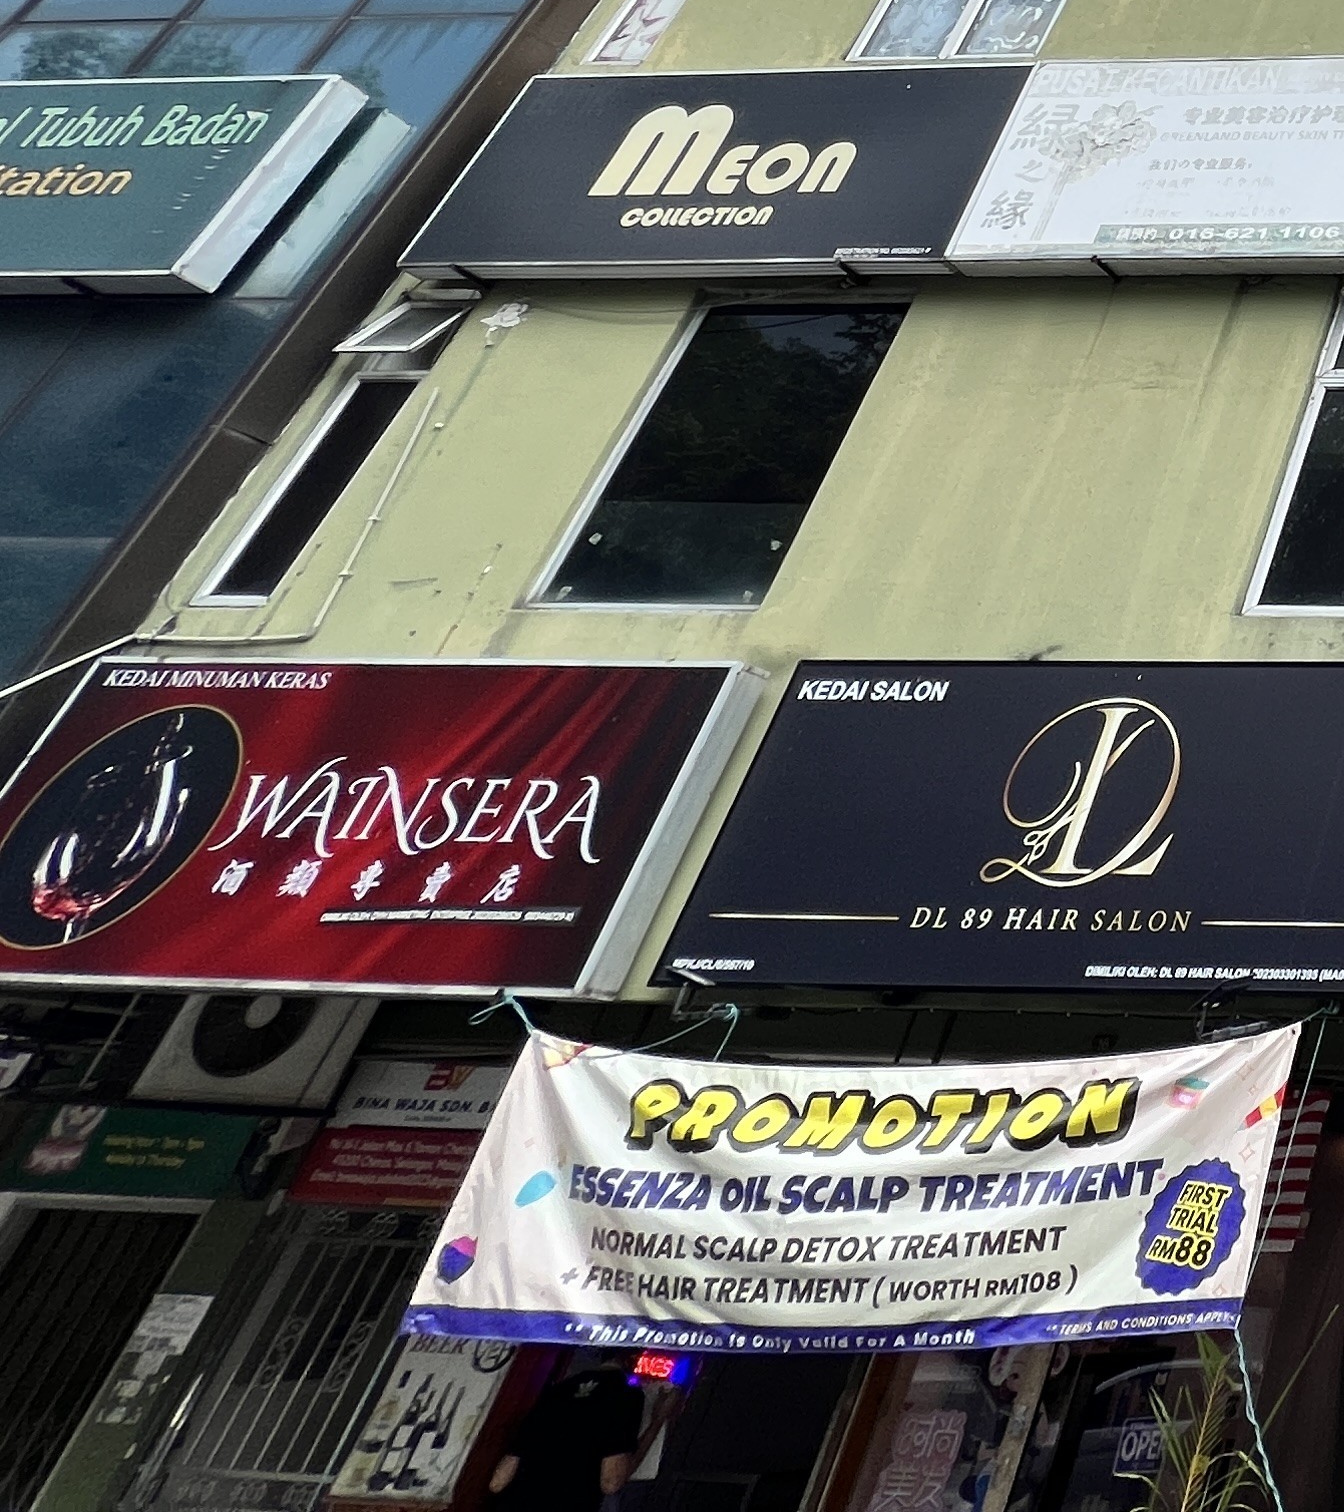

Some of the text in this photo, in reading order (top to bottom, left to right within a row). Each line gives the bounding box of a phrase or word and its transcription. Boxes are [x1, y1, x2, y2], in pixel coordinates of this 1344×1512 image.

[20, 104, 144, 148] Tubuh
[141, 101, 269, 147] Badan
[1242, 130, 1296, 142] BEAUTY
[1297, 130, 1330, 142] SKIN
[102, 668, 333, 690] KEDAI MINUMAN KERAS
[797, 680, 949, 702] KEDAI SALON
[207, 756, 601, 865] WAINSERA
[909, 906, 1192, 933] DL 89 HAIR SALON
[1188, 967, 1213, 979] HAIR
[353, 1096, 391, 1109] BINA
[395, 1098, 438, 1113] WAJA
[624, 1076, 1142, 1156] PROMOTION
[567, 1159, 1165, 1215] ESSENZA OIL SCALP TREATMENT
[1180, 1184, 1228, 1208] FIRST
[1169, 1207, 1216, 1233] TRIAL
[590, 1226, 1068, 1264] NORMAL SCALP DETOX TREATMENT
[1148, 1235, 1211, 1266] RM88
[583, 1265, 636, 1295] FREE
[637, 1270, 701, 1299] HAIR
[703, 1275, 869, 1305] TREATMENT
[888, 1275, 982, 1303] WORTH
[985, 1271, 1062, 1297] RM108
[1060, 1322, 1092, 1335] TERMS
[1095, 1320, 1118, 1332] AND
[1121, 1313, 1192, 1329] CONDITIONS
[589, 1325, 629, 1342] This
[632, 1326, 723, 1347] Promotion
[752, 1334, 792, 1353] Only
[799, 1335, 849, 1350] Valid
[855, 1335, 887, 1348] For
[893, 1333, 906, 1348] A
[913, 1328, 975, 1346] Month
[1121, 1429, 1162, 1462] OPE
